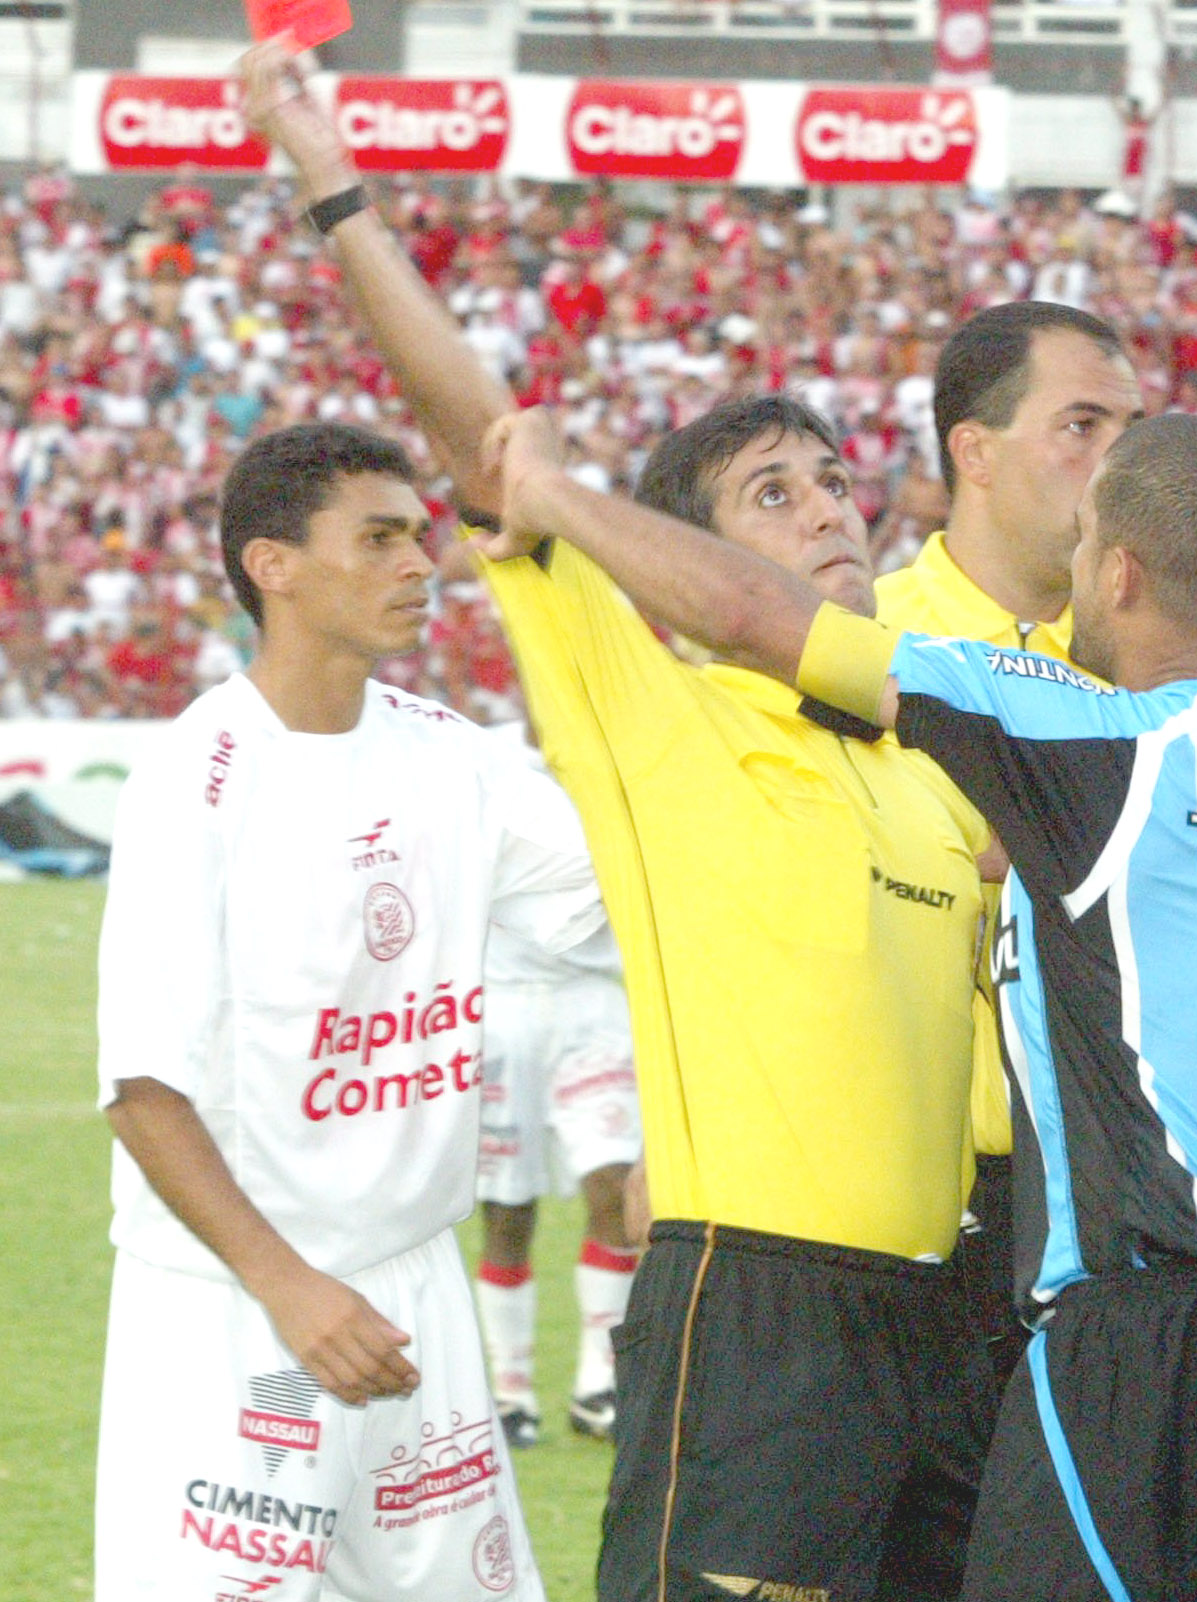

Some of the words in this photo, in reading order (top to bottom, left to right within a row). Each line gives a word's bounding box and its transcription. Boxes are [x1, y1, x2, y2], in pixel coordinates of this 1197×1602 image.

[104, 96, 246, 149] Claro
[338, 100, 480, 152] Claro
[572, 104, 715, 158] Claro
[801, 111, 946, 163] Claro
[886, 877, 956, 911] PENALTY
[243, 1415, 314, 1444] NASSAU
[185, 1479, 338, 1538] CIMENTO
